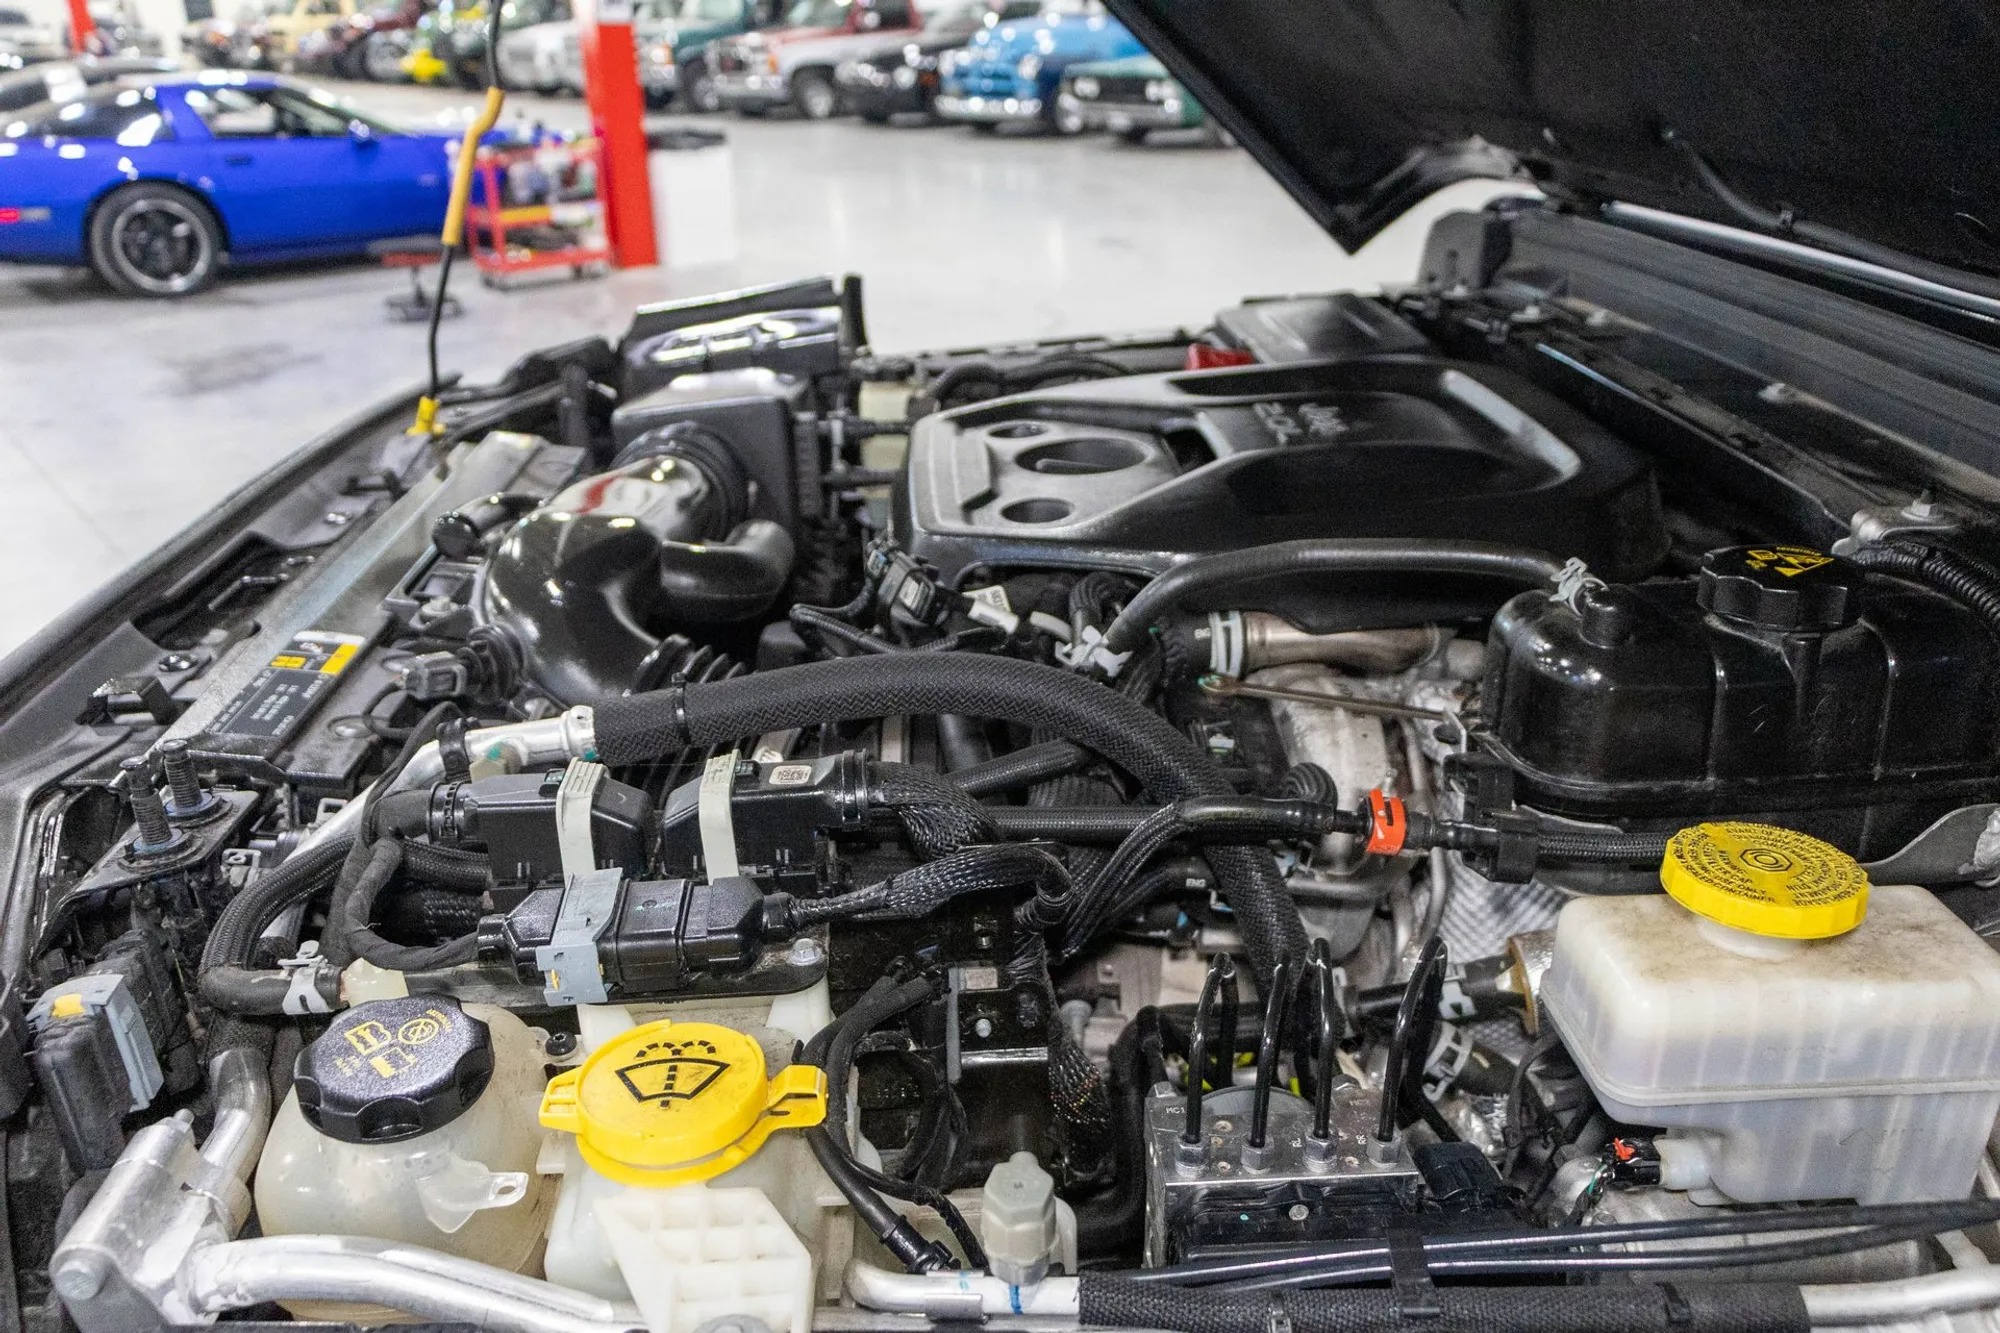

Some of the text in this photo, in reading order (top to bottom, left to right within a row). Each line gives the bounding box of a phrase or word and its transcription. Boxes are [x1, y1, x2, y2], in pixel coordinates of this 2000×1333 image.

[1714, 875, 1736, 886] USE
[1737, 884, 1767, 895] ONLY
[1731, 874, 1752, 884] CAP
[1713, 882, 1776, 903] CONTAINER
